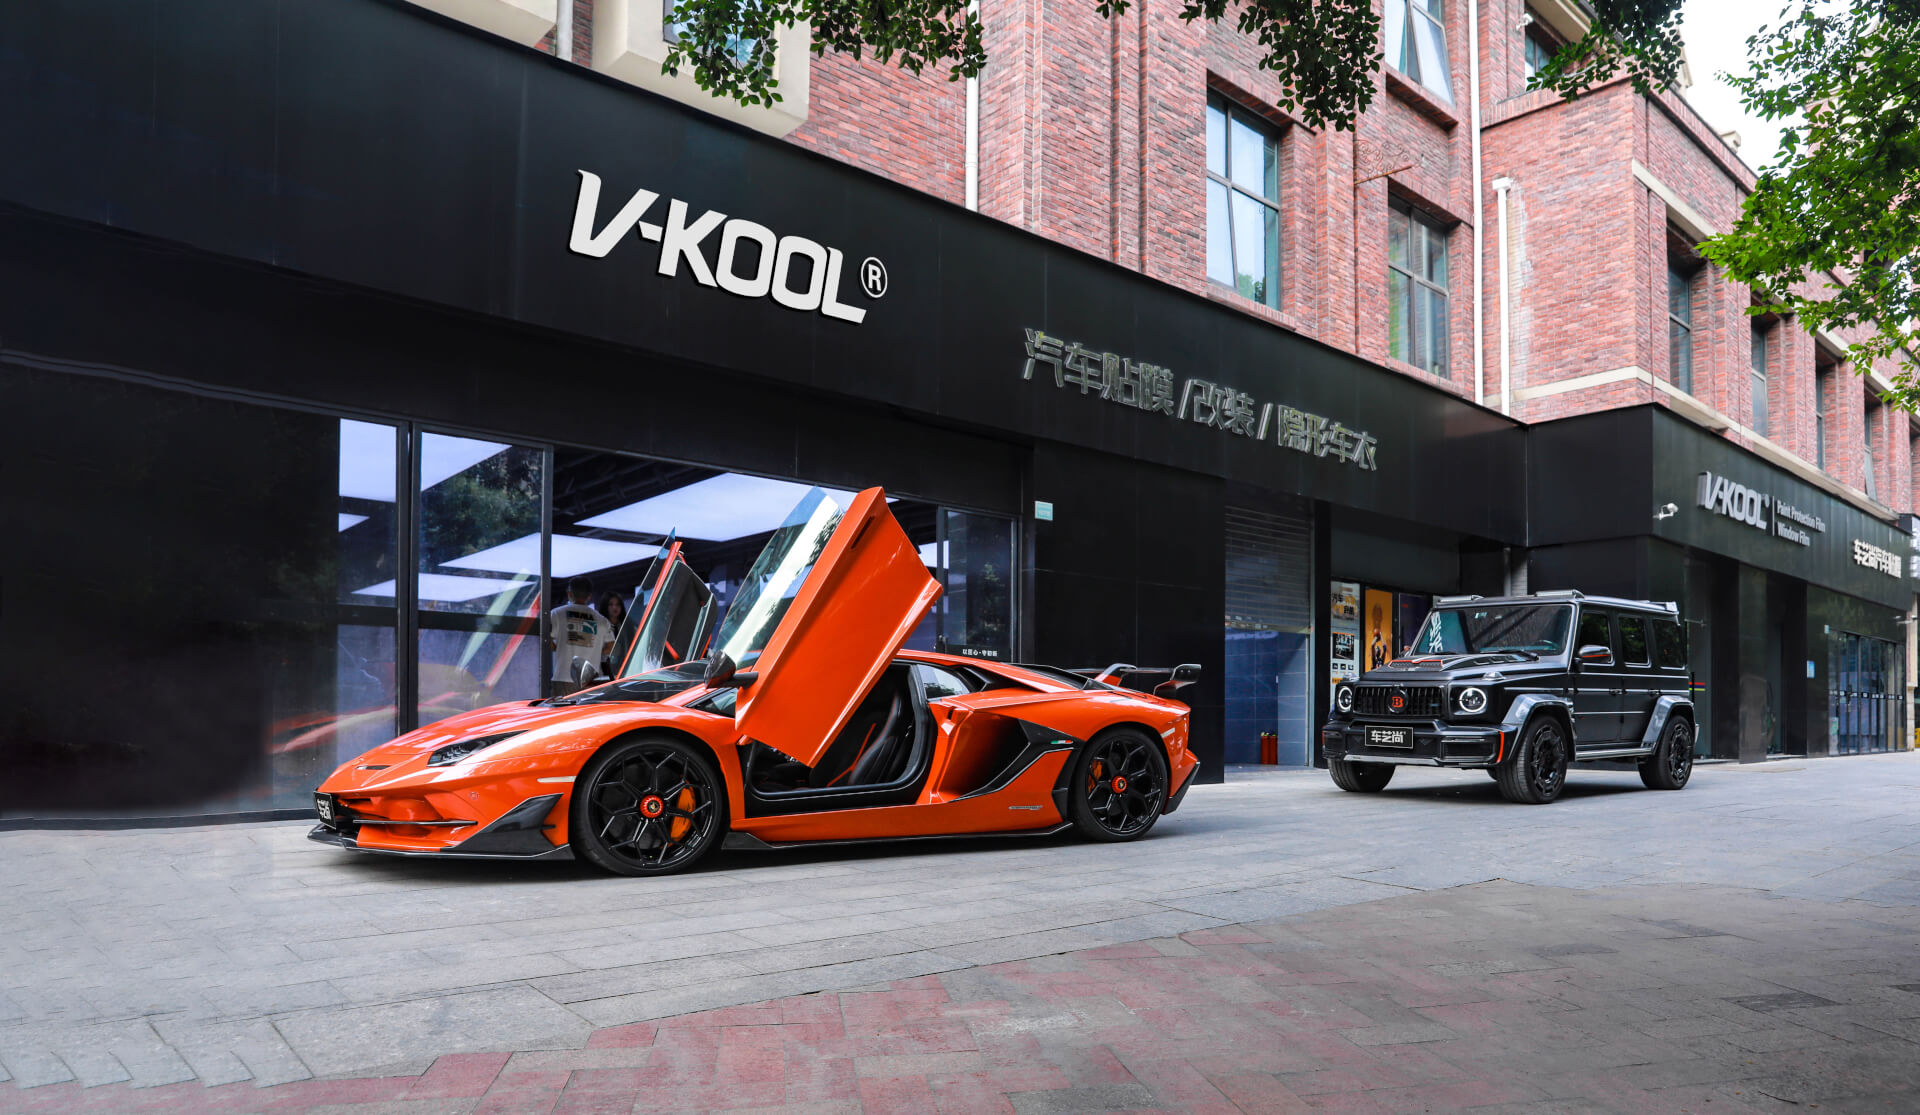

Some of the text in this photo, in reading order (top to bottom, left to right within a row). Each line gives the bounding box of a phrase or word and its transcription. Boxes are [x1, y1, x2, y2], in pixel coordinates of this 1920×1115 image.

[569, 168, 867, 324] V-KOOL
[1024, 327, 1174, 416] 汽车贴膜
[1193, 379, 1255, 437] 改装
[1278, 404, 1377, 471] 隐形车衣
[1704, 471, 1767, 530] V-KOOL
[1776, 500, 1826, 533] Paint Protection Film
[1777, 520, 1810, 547] Window Film
[1370, 729, 1404, 744] 车艺尚
